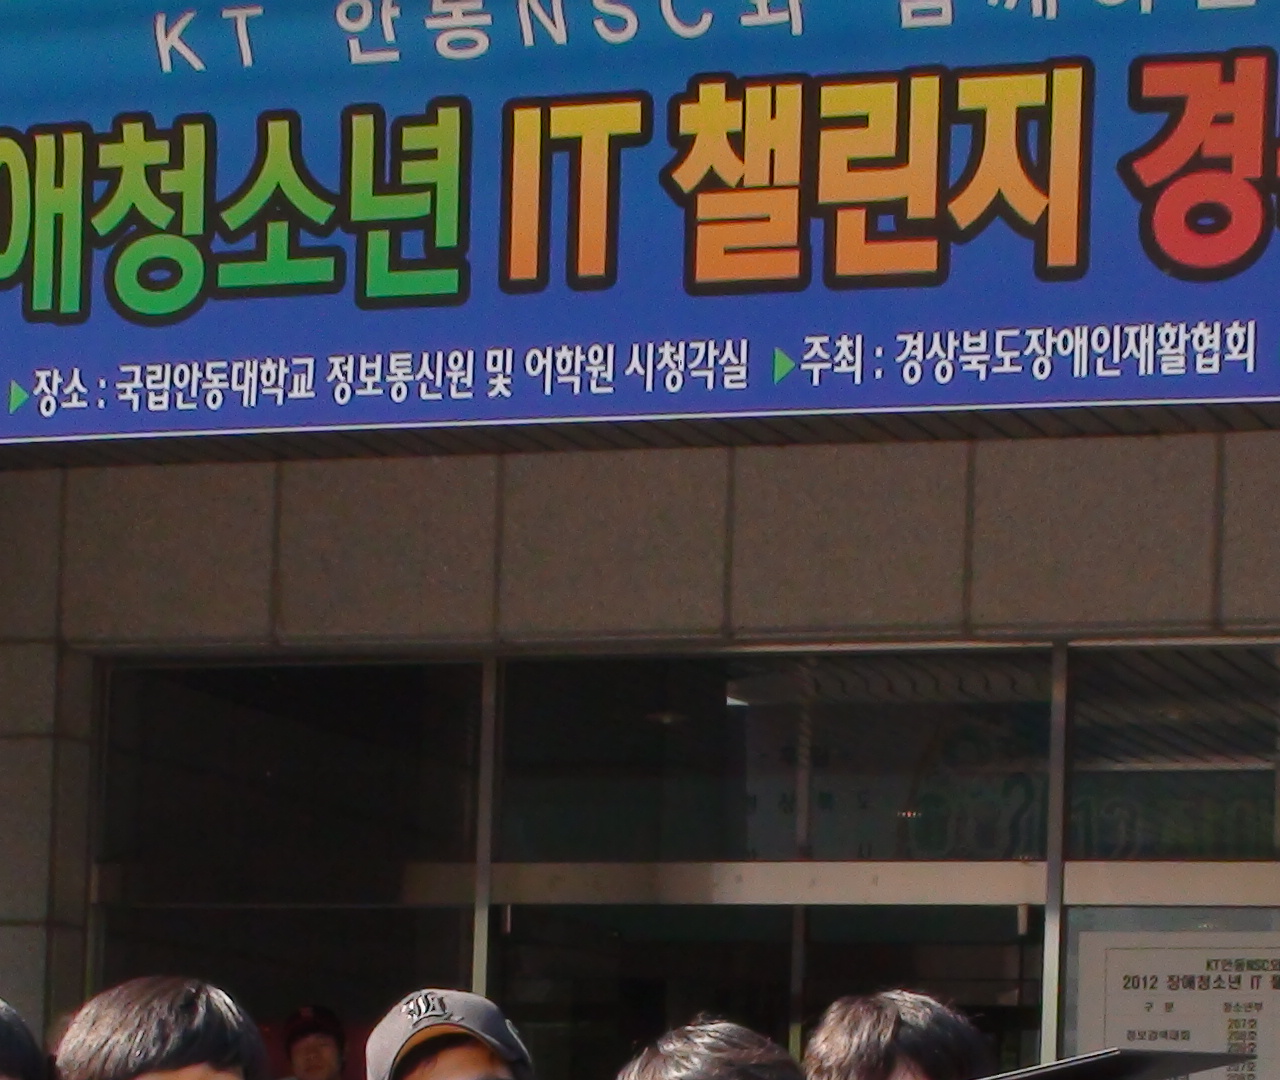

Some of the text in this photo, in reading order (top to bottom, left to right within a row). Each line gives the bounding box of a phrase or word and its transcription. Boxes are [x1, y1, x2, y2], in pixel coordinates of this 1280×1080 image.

[505, 97, 646, 285] IT
[669, 62, 1088, 287] 챌린지
[115, 356, 316, 412] 국립안동대학교
[326, 349, 474, 405] 정보통신원
[485, 347, 514, 398] 및
[525, 344, 616, 395] 어학원
[625, 338, 749, 392] 시청각실
[895, 320, 1256, 386] 경상북도장애인재활협회
[1122, 974, 1158, 990] 2012
[1166, 974, 1243, 990] 장애청소년
[1250, 974, 1262, 990] IT
